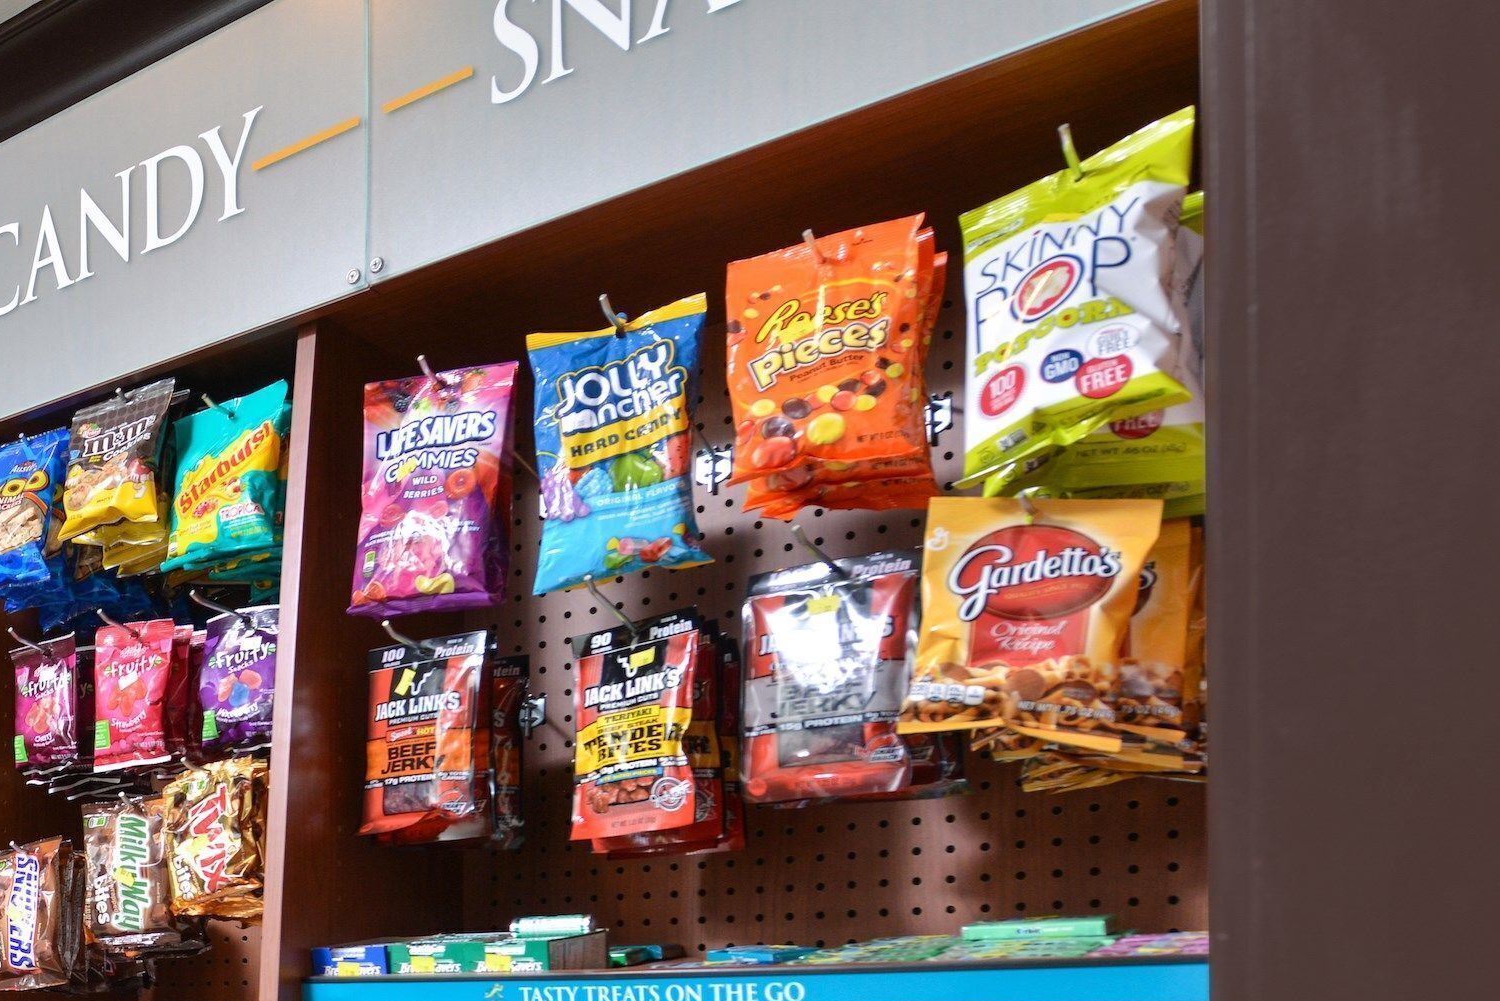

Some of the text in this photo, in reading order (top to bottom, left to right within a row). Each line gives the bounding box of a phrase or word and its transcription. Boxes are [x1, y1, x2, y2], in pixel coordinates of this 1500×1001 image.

[490, 0, 742, 104] SN
[977, 197, 1140, 295] SKINNY
[557, 343, 668, 413] JOLLY
[1044, 358, 1078, 382] GMO
[1080, 364, 1128, 394] FREE
[571, 435, 619, 457] HARD
[385, 448, 478, 483] GMMIES
[412, 475, 438, 486] WILD
[403, 485, 444, 499] BERRIES
[948, 544, 1122, 622] Gardetto's
[590, 632, 612, 648] 90
[650, 619, 693, 640] Protein
[990, 618, 1067, 640] Original
[998, 636, 1057, 653] Recipe
[381, 648, 405, 664] 100
[585, 667, 680, 708] JACK LINK'S
[375, 691, 461, 722] JACK LINK'S
[600, 699, 637, 711] PREMIUM
[604, 708, 652, 724] TERIYAKI
[388, 715, 419, 726] PREMIUM
[804, 714, 863, 729] PROTEIN
[584, 722, 684, 755] TENDER
[388, 741, 438, 760] BEEF
[598, 738, 663, 763] BITES
[382, 755, 445, 774] JERKY
[399, 772, 437, 784] PROTEIN
[93, 875, 110, 925] bites
